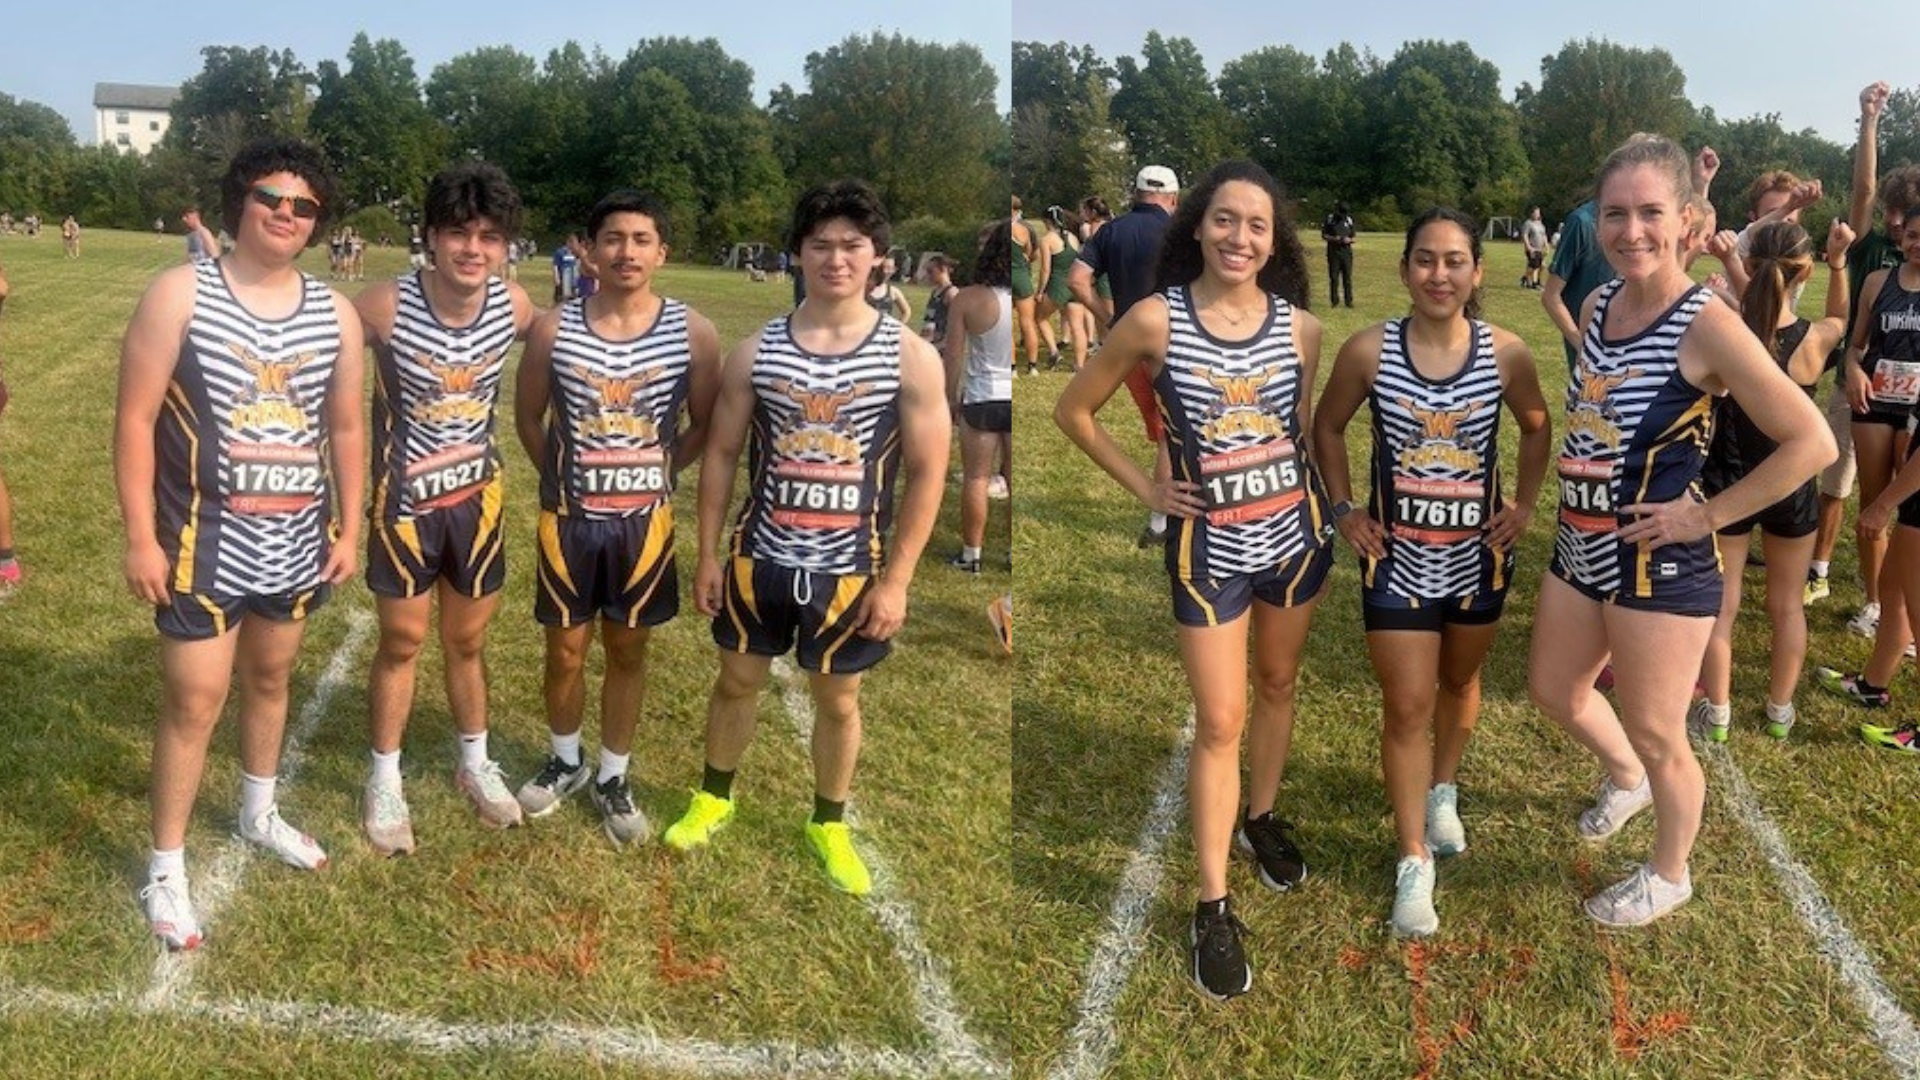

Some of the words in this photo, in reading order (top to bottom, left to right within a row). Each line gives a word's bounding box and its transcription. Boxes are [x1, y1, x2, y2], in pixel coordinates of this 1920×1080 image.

[232, 463, 318, 492] 17622
[413, 458, 485, 500] 17627
[585, 467, 663, 492] 17626
[1208, 460, 1298, 504] 17615
[778, 480, 860, 510] 17619
[1558, 479, 1610, 511] 614
[1397, 497, 1481, 526] 17616
